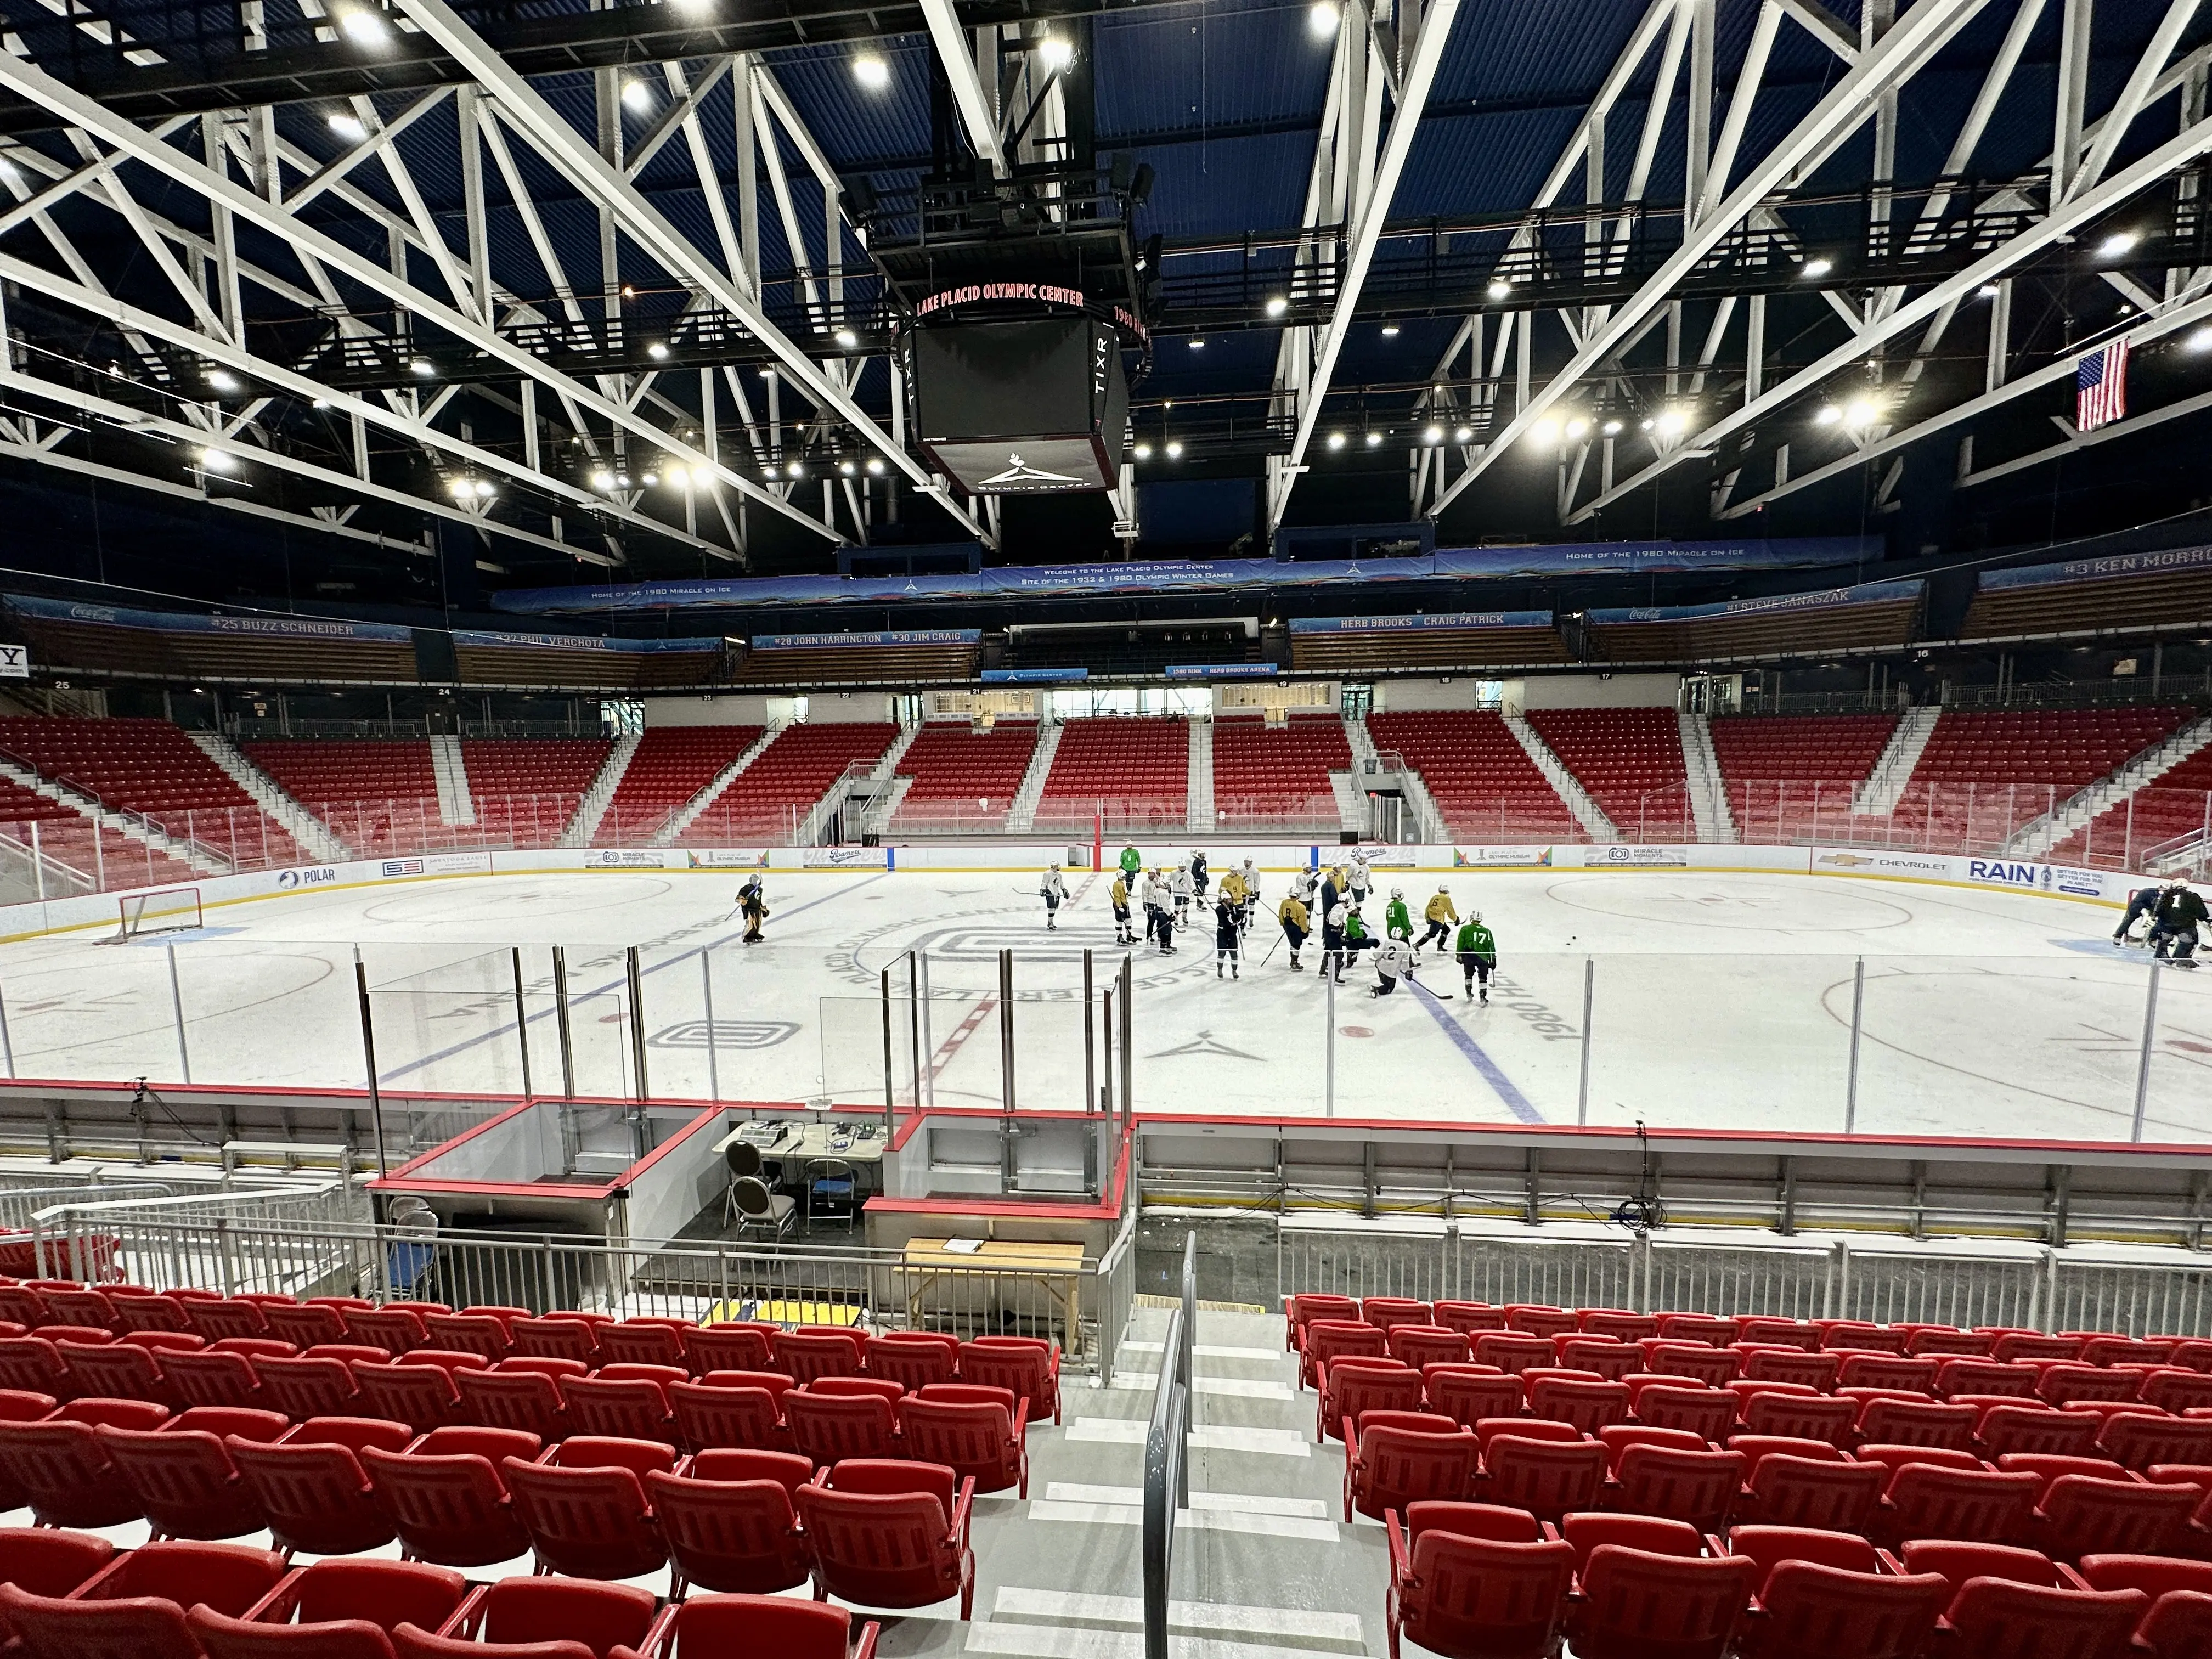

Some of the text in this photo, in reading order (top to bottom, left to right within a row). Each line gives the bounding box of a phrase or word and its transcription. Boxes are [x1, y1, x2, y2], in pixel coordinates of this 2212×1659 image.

[917, 283, 1084, 317] LAKE PLACID OLYMPIC CENTER
[1114, 306, 1133, 328] 1980
[1095, 337, 1108, 394] TIXR
[2063, 563, 2088, 574] #3
[2095, 557, 2137, 573] KEN
[1740, 599, 1779, 611] STEVE
[211, 618, 354, 636] #25 BUZZ SCHNEIDER
[1341, 614, 1504, 628] HERB BROOKS CRAIG PATRICK
[520, 635, 543, 644] PHIL
[549, 636, 605, 648] VERCHOTA
[774, 632, 961, 646] #28 JOHN HARRINGTON #30 JIM CRAIG
[55, 681, 70, 690] 25
[829, 849, 862, 859] Roamers
[1879, 859, 1948, 871] CHEVROLET
[1969, 860, 2035, 883] RAIN
[304, 868, 335, 884] POLAR
[1432, 898, 1438, 907] 6
[2171, 894, 2180, 908] 1
[1387, 907, 1396, 918] 21
[1473, 932, 1486, 944] 17
[1387, 946, 1396, 961] 2
[823, 952, 881, 984] PLACID
[1507, 1002, 1582, 1041] 1980
